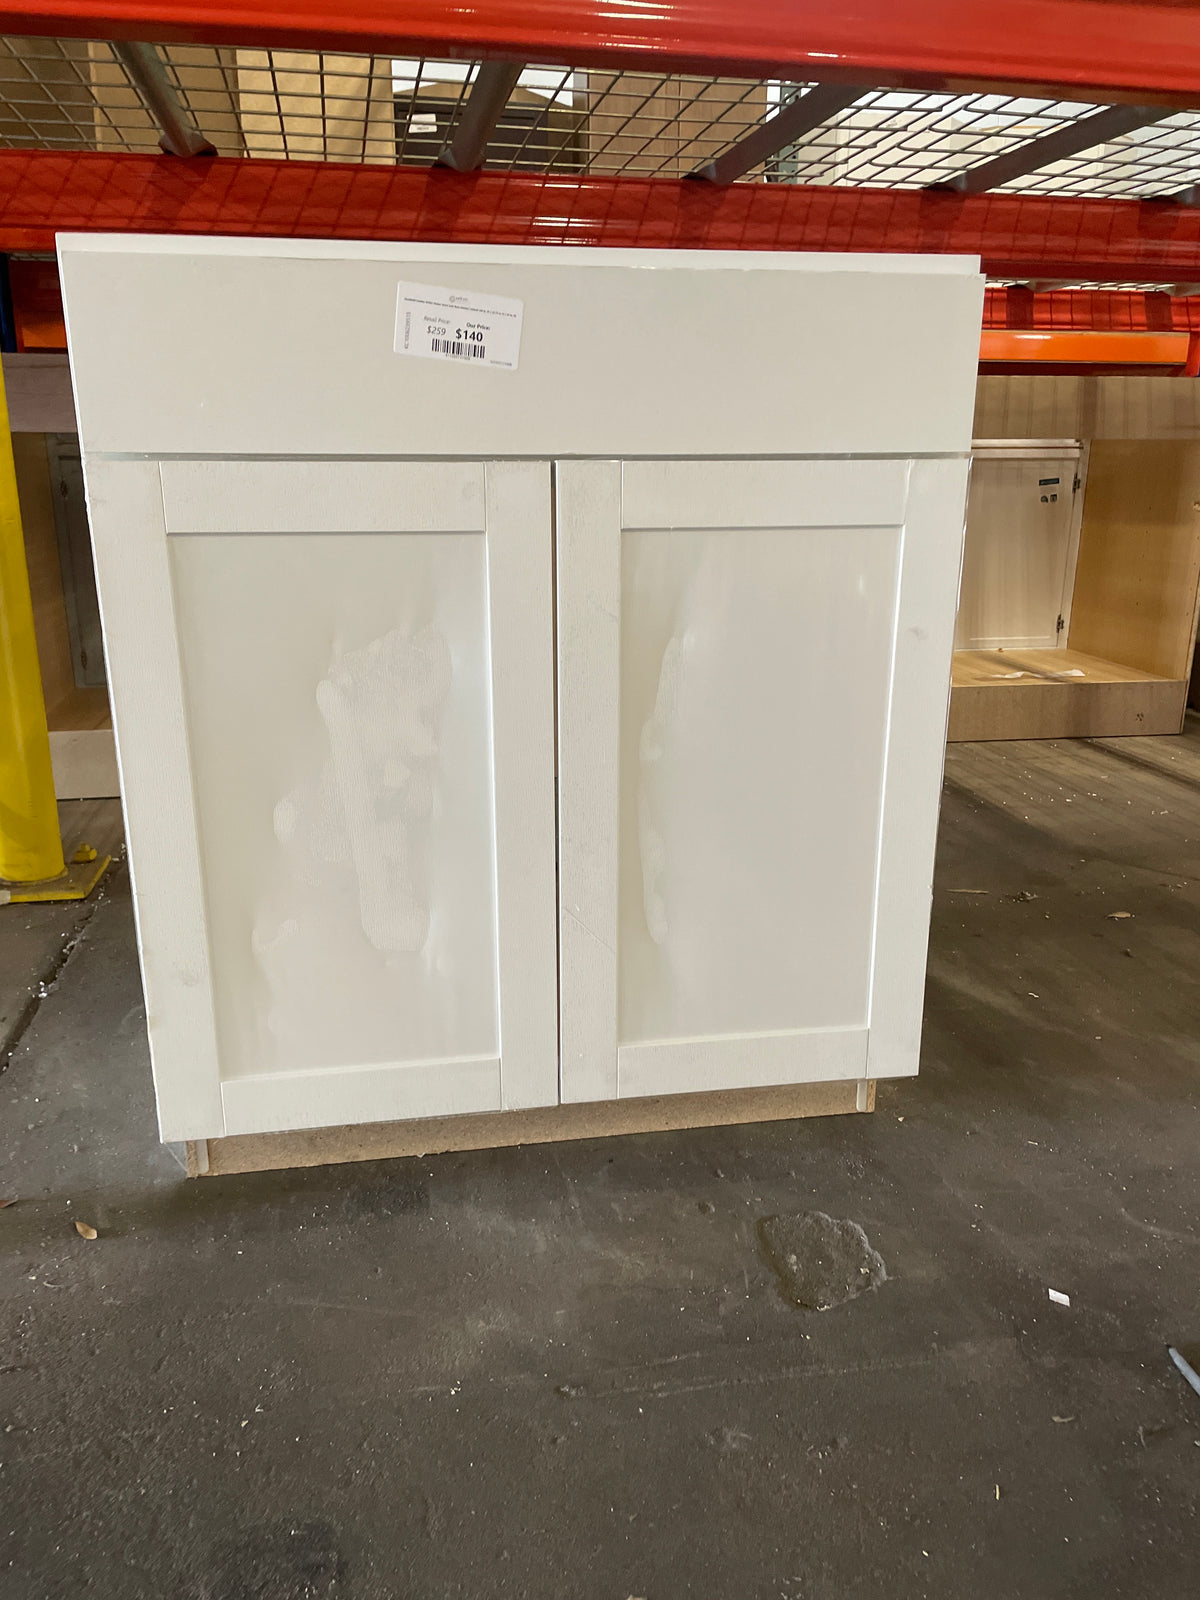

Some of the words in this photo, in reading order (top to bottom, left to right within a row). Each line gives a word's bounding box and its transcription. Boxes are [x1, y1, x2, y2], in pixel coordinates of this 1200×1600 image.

[424, 315, 437, 323] Retail
[427, 325, 447, 336] $259
[476, 323, 491, 331] Price:
[455, 327, 483, 342] $140
